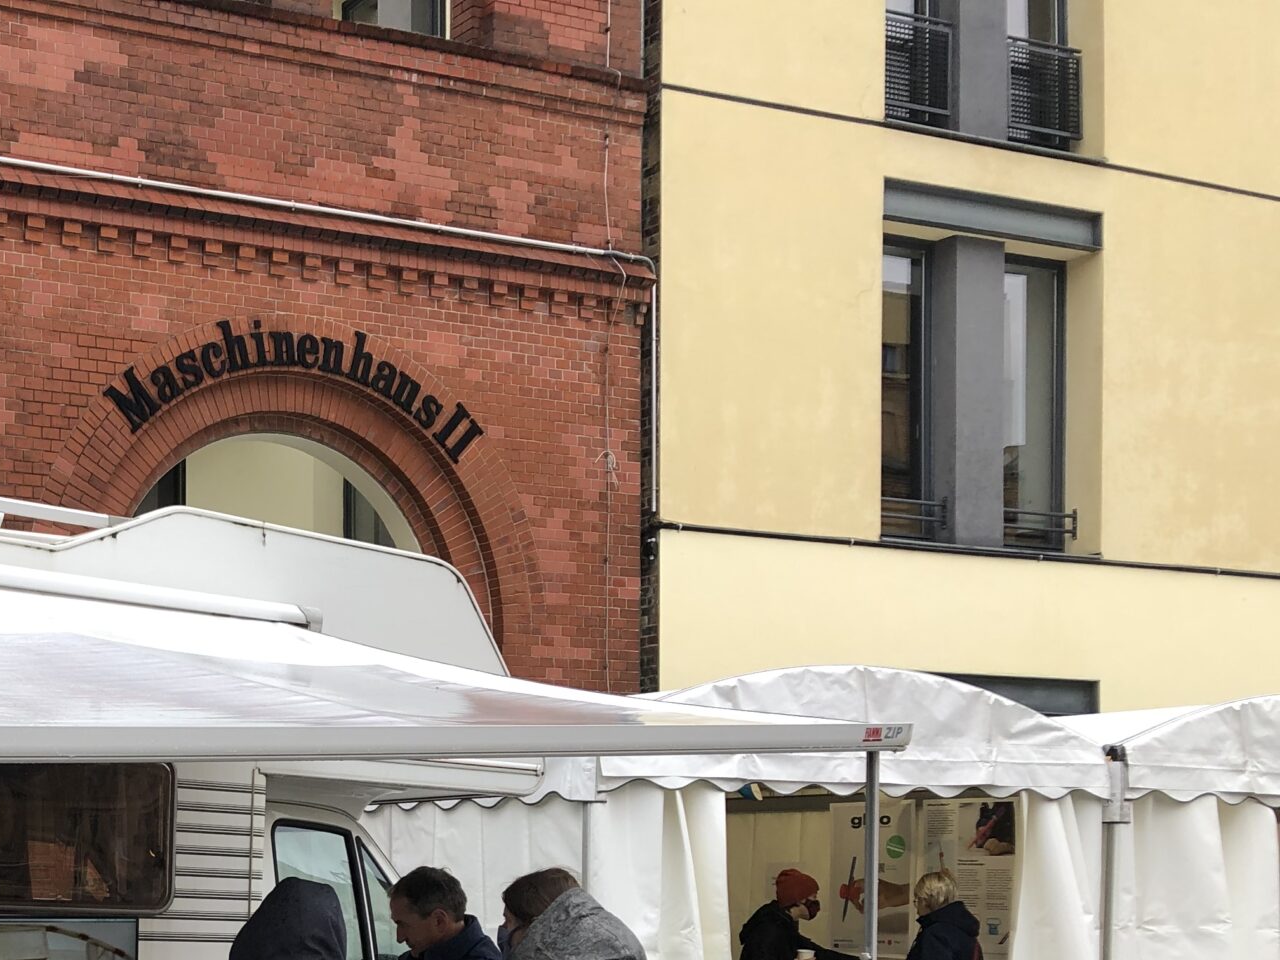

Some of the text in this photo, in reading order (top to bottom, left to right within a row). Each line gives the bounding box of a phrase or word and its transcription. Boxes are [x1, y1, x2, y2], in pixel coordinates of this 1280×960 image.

[103, 319, 485, 464] Maschinenhaus II
[884, 727, 903, 739] ZIP
